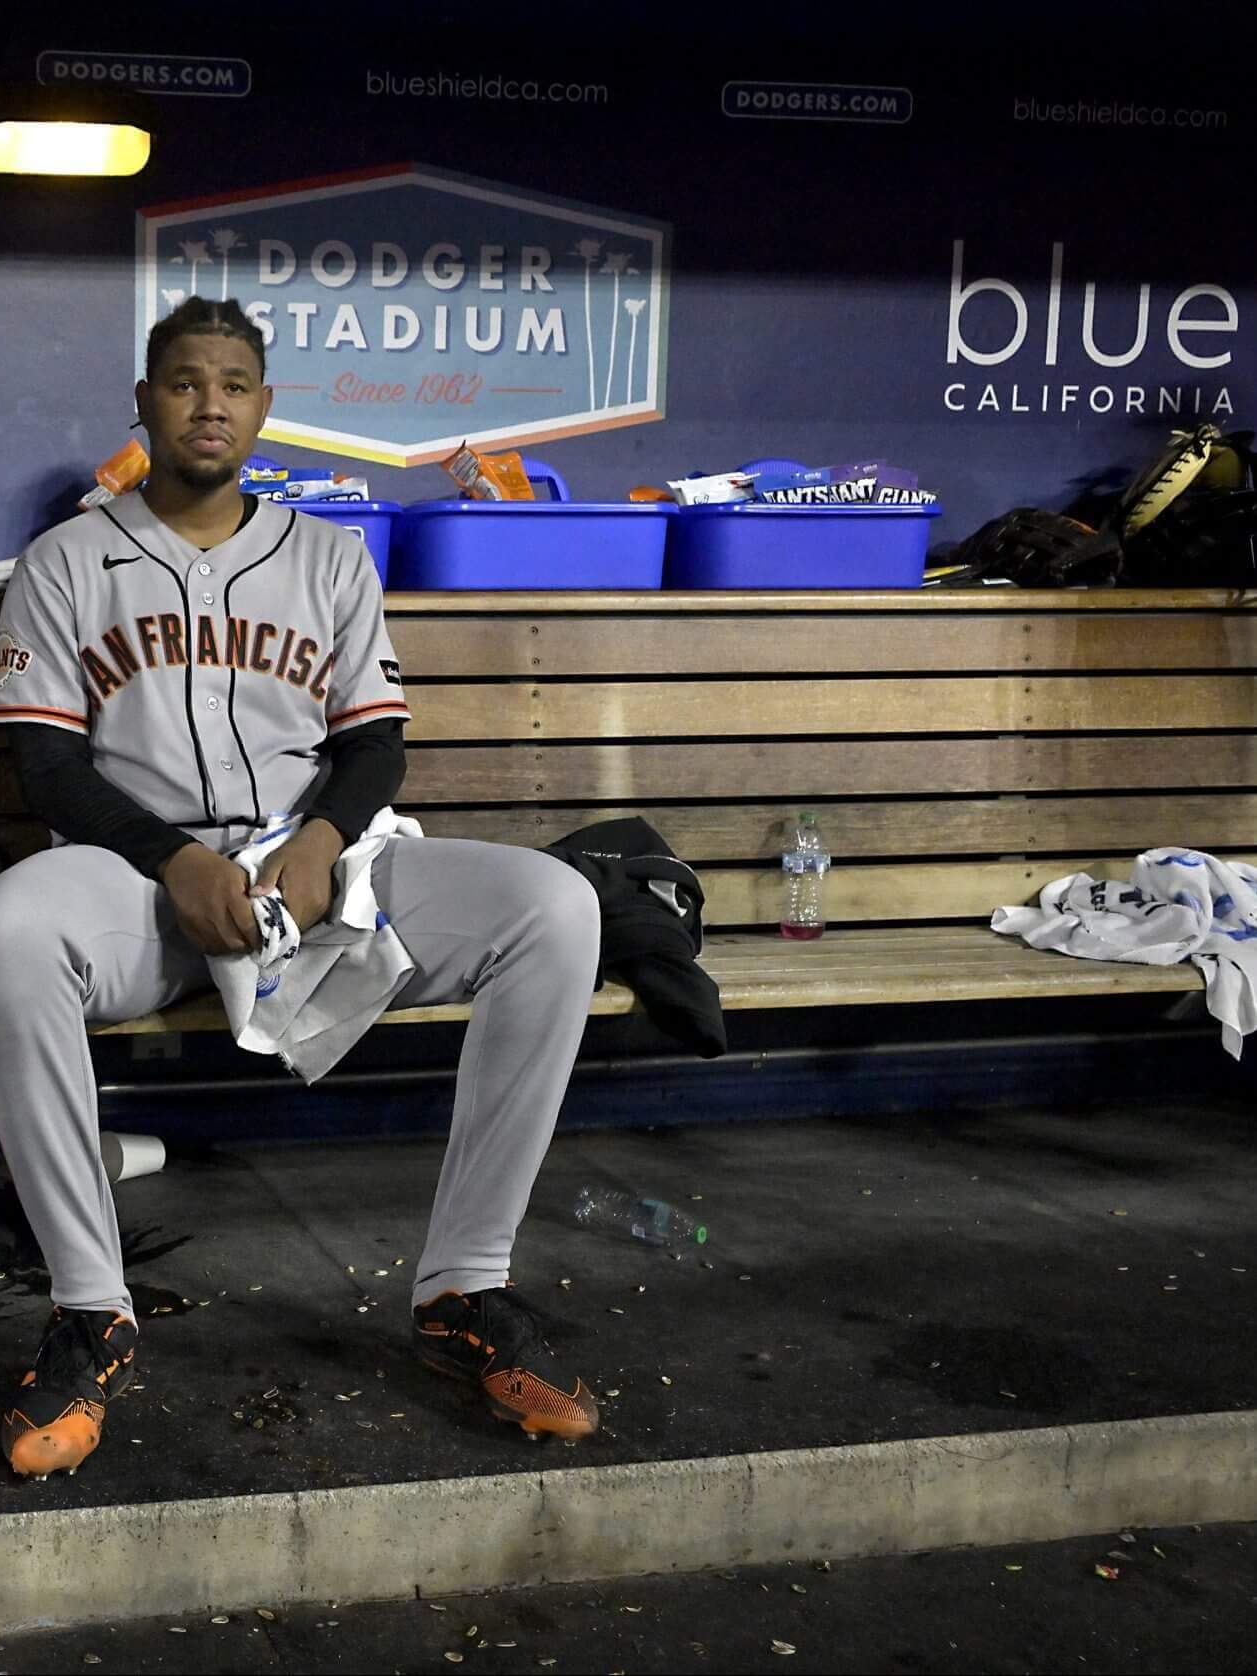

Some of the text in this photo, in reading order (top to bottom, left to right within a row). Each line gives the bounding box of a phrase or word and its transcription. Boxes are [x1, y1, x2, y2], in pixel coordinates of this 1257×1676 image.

[53, 61, 235, 87] DODGERS.COM
[366, 70, 609, 104] blueshieldca.com
[736, 91, 898, 113] DODGERS.COM
[1013, 96, 1229, 127] blueshieldca.com
[258, 238, 555, 292] DODGER
[946, 239, 1239, 369] blue
[244, 301, 567, 353] STADIUM
[331, 371, 485, 405] Since 1962
[943, 383, 1235, 415] CALIFORNIA
